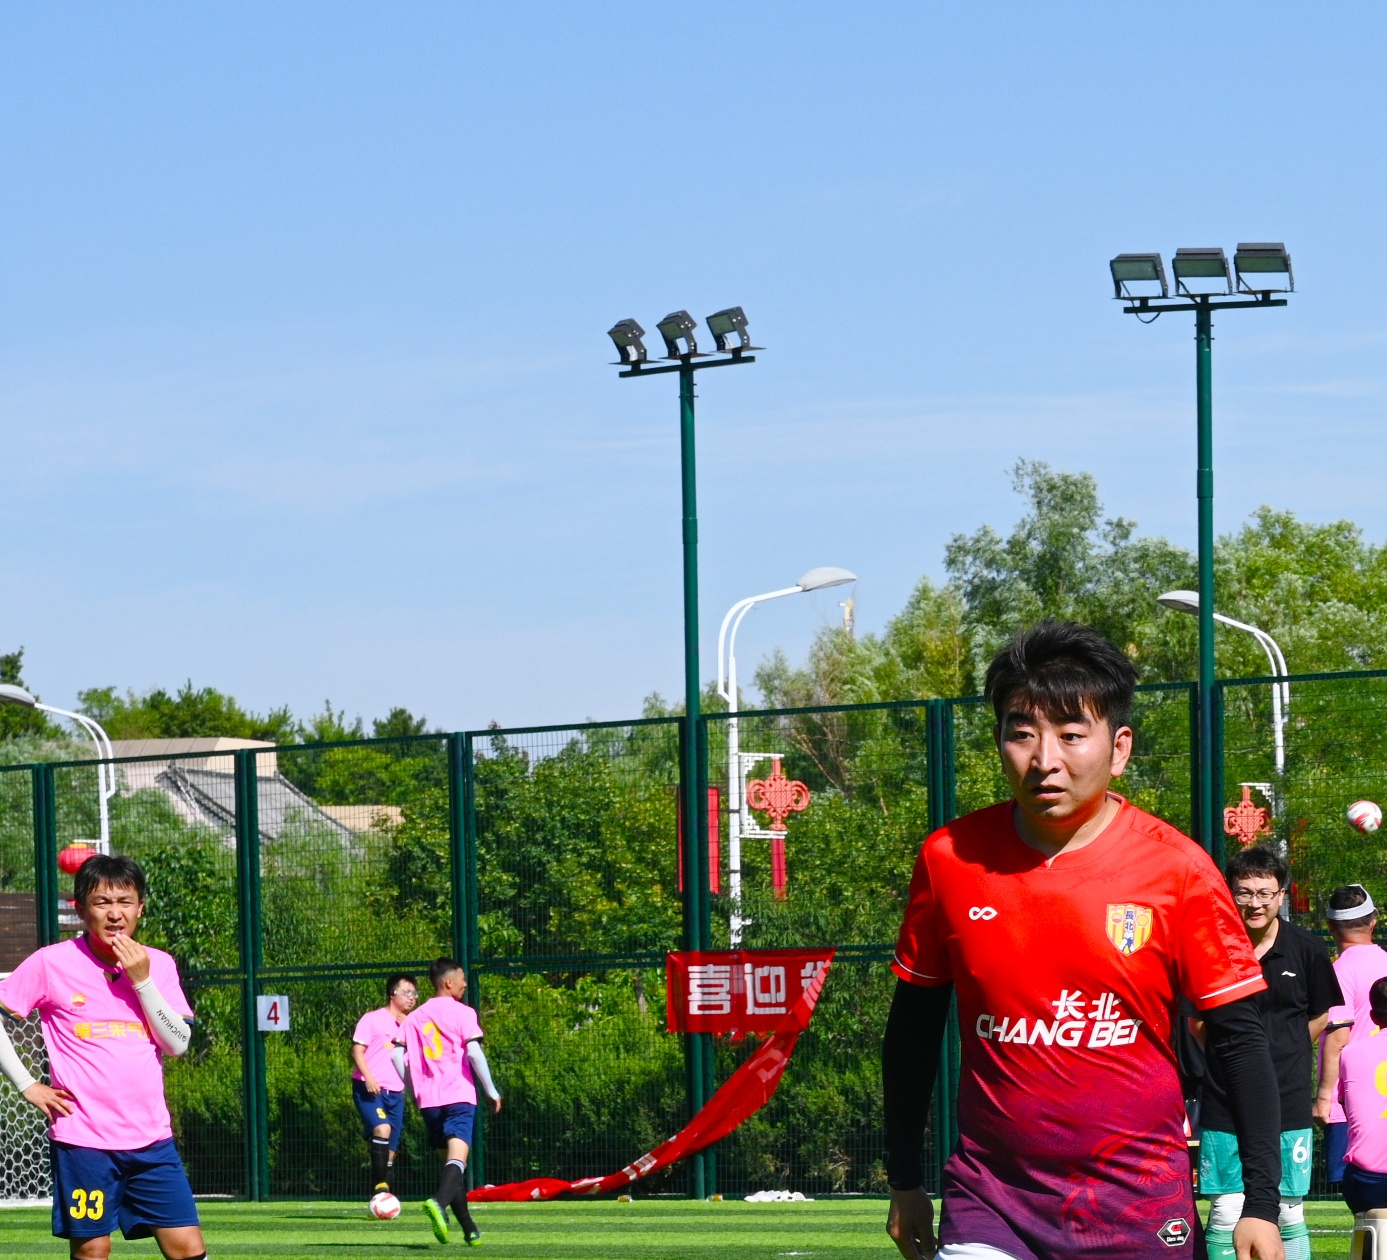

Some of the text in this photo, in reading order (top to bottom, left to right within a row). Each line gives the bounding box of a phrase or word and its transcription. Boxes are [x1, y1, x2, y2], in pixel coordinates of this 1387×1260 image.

[267, 1001, 280, 1025] 4
[1051, 989, 1122, 1020] 长北
[74, 1020, 149, 1040] 第三采气
[156, 1009, 188, 1043] QIUCHUAN
[422, 1021, 443, 1061] 3
[975, 1013, 1144, 1048] CHANG BEI
[1292, 1136, 1309, 1164] 6
[70, 1188, 104, 1221] 33
